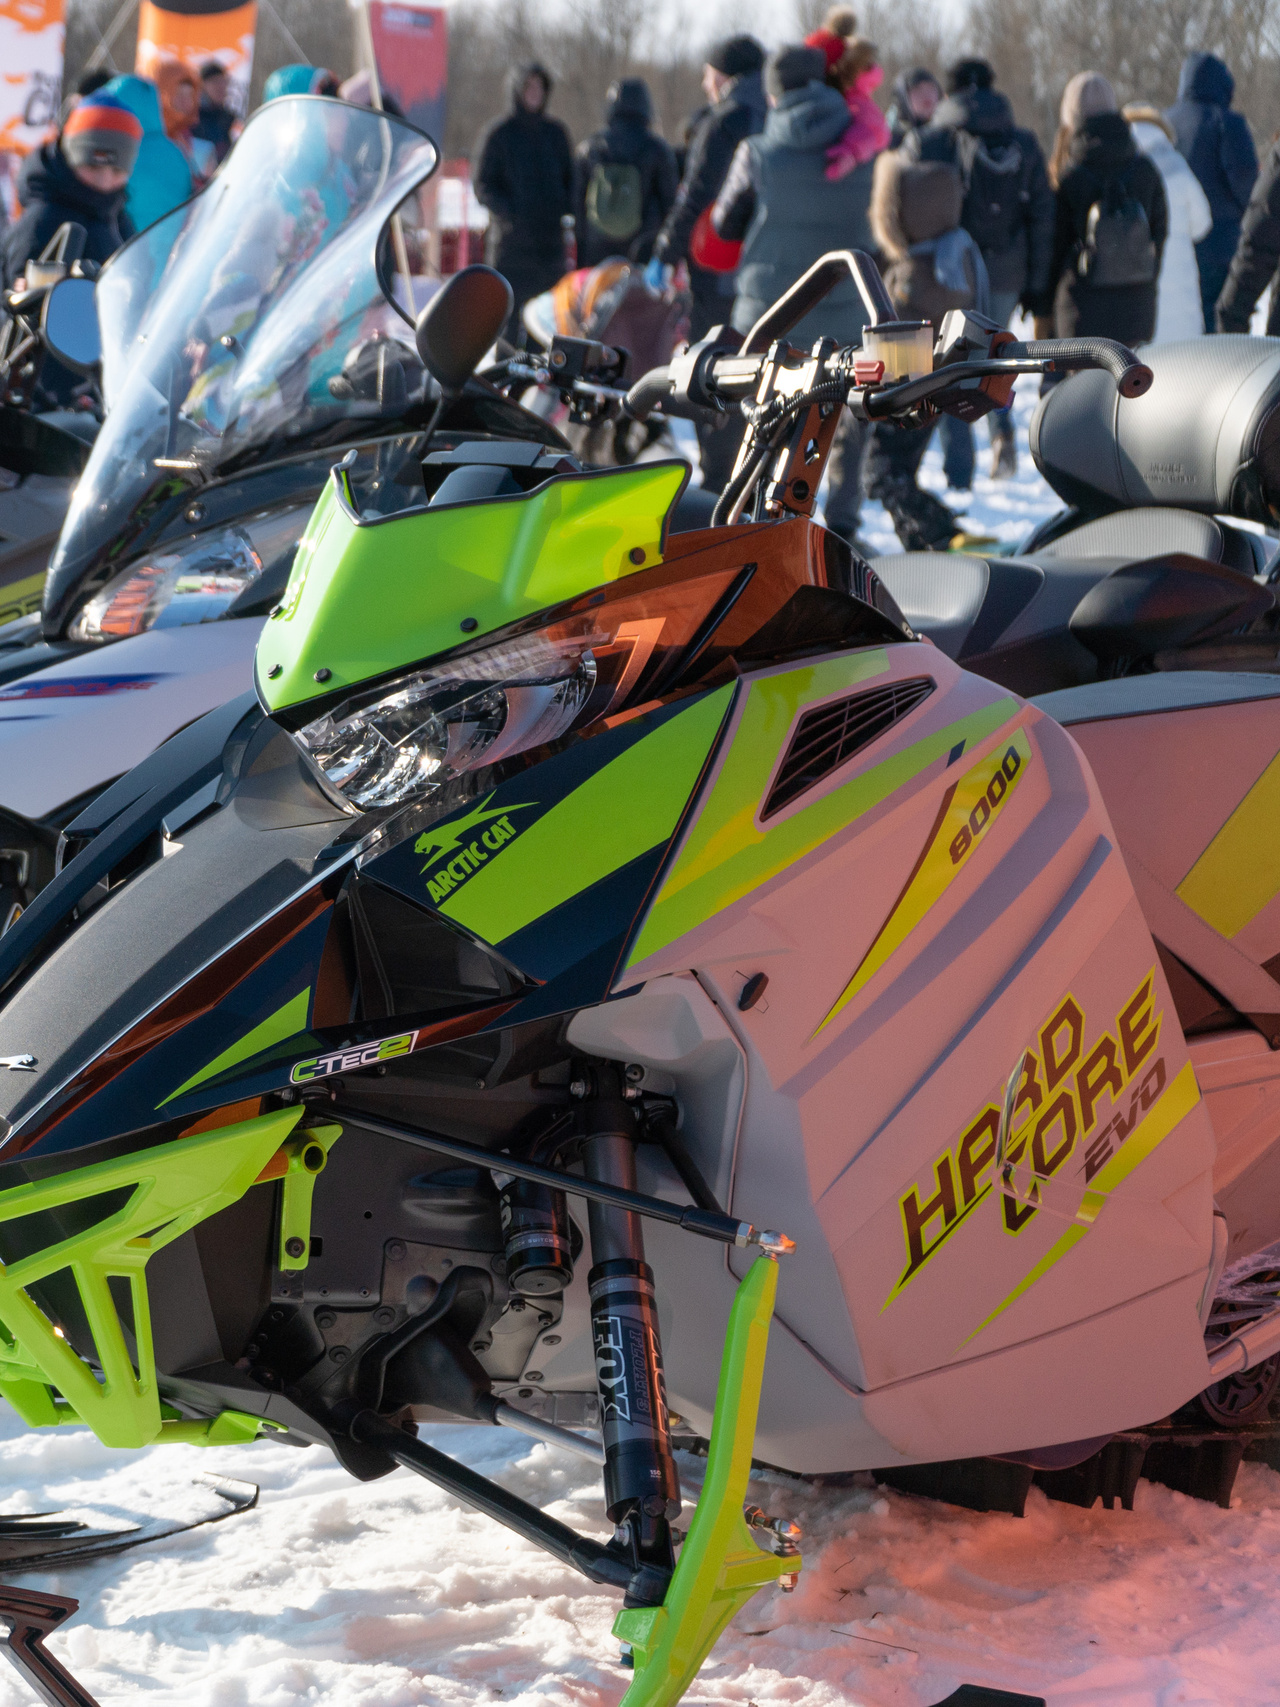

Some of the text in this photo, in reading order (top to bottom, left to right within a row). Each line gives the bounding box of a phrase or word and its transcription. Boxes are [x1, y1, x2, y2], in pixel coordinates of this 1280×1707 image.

[426, 815, 517, 904] ARCTIC CAT
[948, 745, 1022, 866] 8000
[885, 992, 1087, 1306] HARD
[1075, 1057, 1167, 1185] EVO
[592, 1316, 631, 1422] FOX
[629, 1329, 648, 1398] FLOAT
